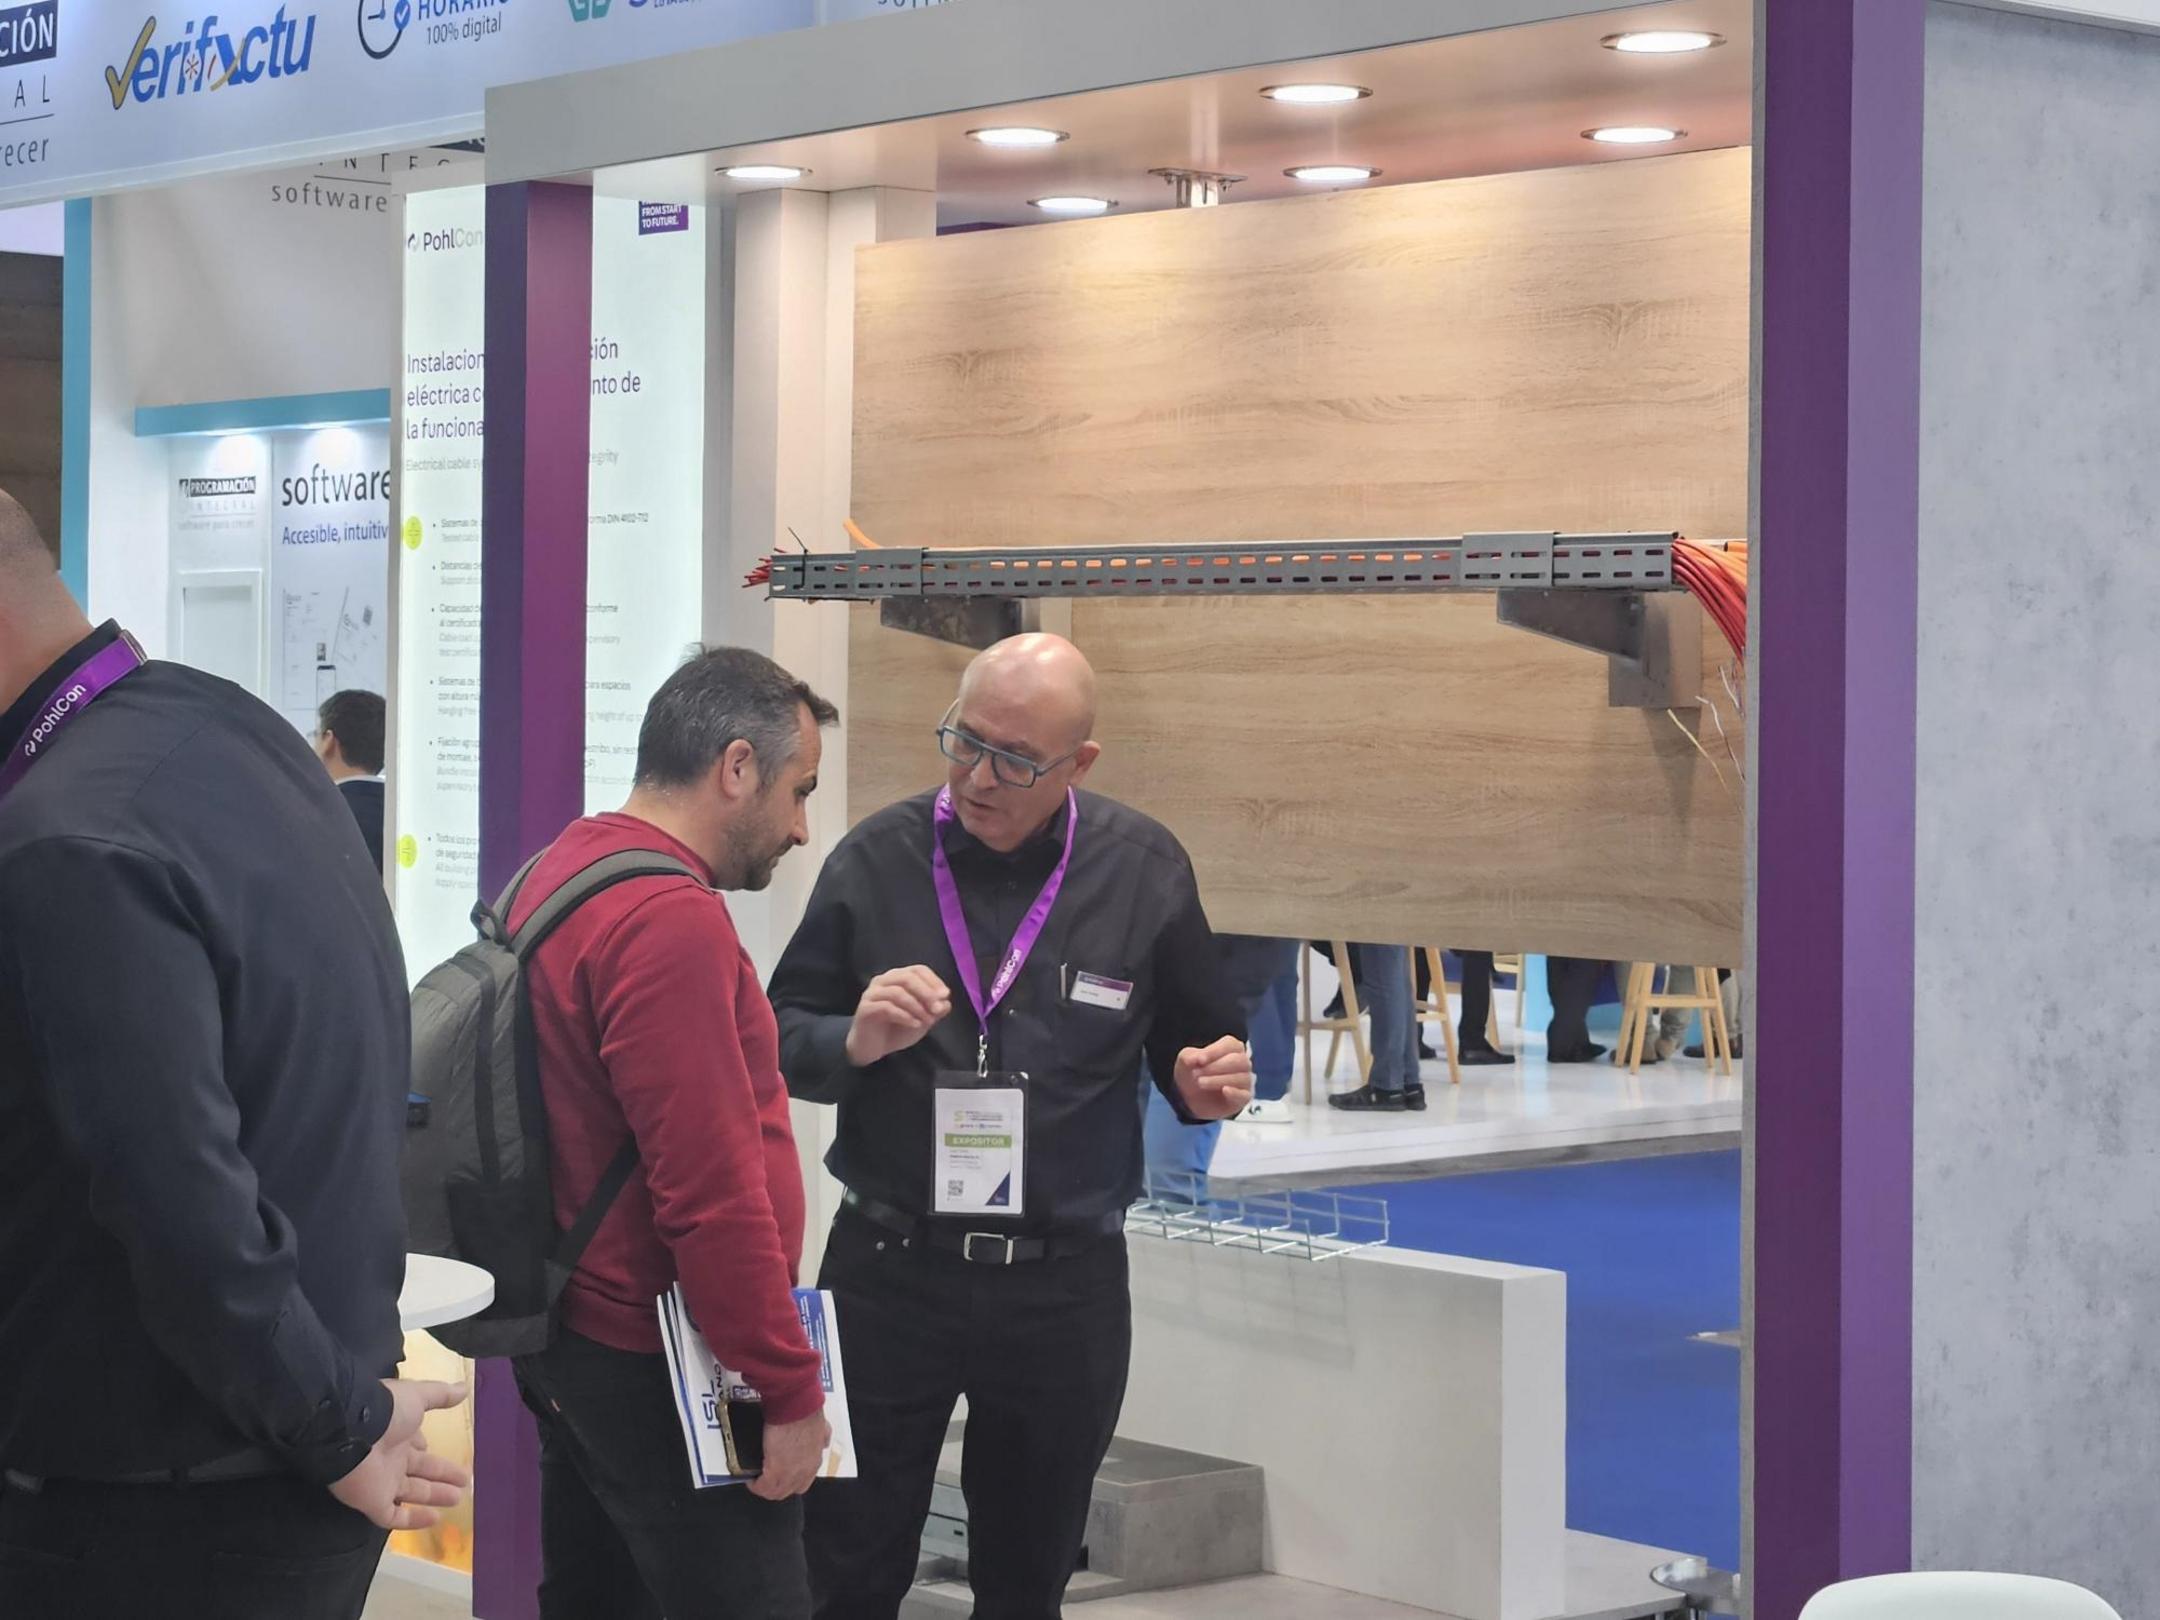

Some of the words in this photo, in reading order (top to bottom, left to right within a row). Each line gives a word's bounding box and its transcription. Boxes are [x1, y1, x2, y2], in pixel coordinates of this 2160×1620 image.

[427, 22, 459, 45] 100%
[462, 11, 501, 42] digital
[0, 138, 49, 166] ecer
[272, 183, 387, 212] software
[642, 206, 661, 217] FROM
[662, 204, 682, 215] START
[642, 218, 652, 228] TO
[424, 228, 483, 251] PohlCon
[590, 337, 618, 359] ión
[407, 383, 470, 407] eléctrica
[592, 375, 617, 395] nto
[621, 370, 641, 393] de
[406, 418, 419, 440] la
[191, 477, 255, 495] PROGRAMACIÓN
[282, 463, 391, 507] software
[282, 523, 341, 545] Accesible,
[32, 684, 87, 743] PohlCon
[952, 1137, 1005, 1147] EXPOSITOR
